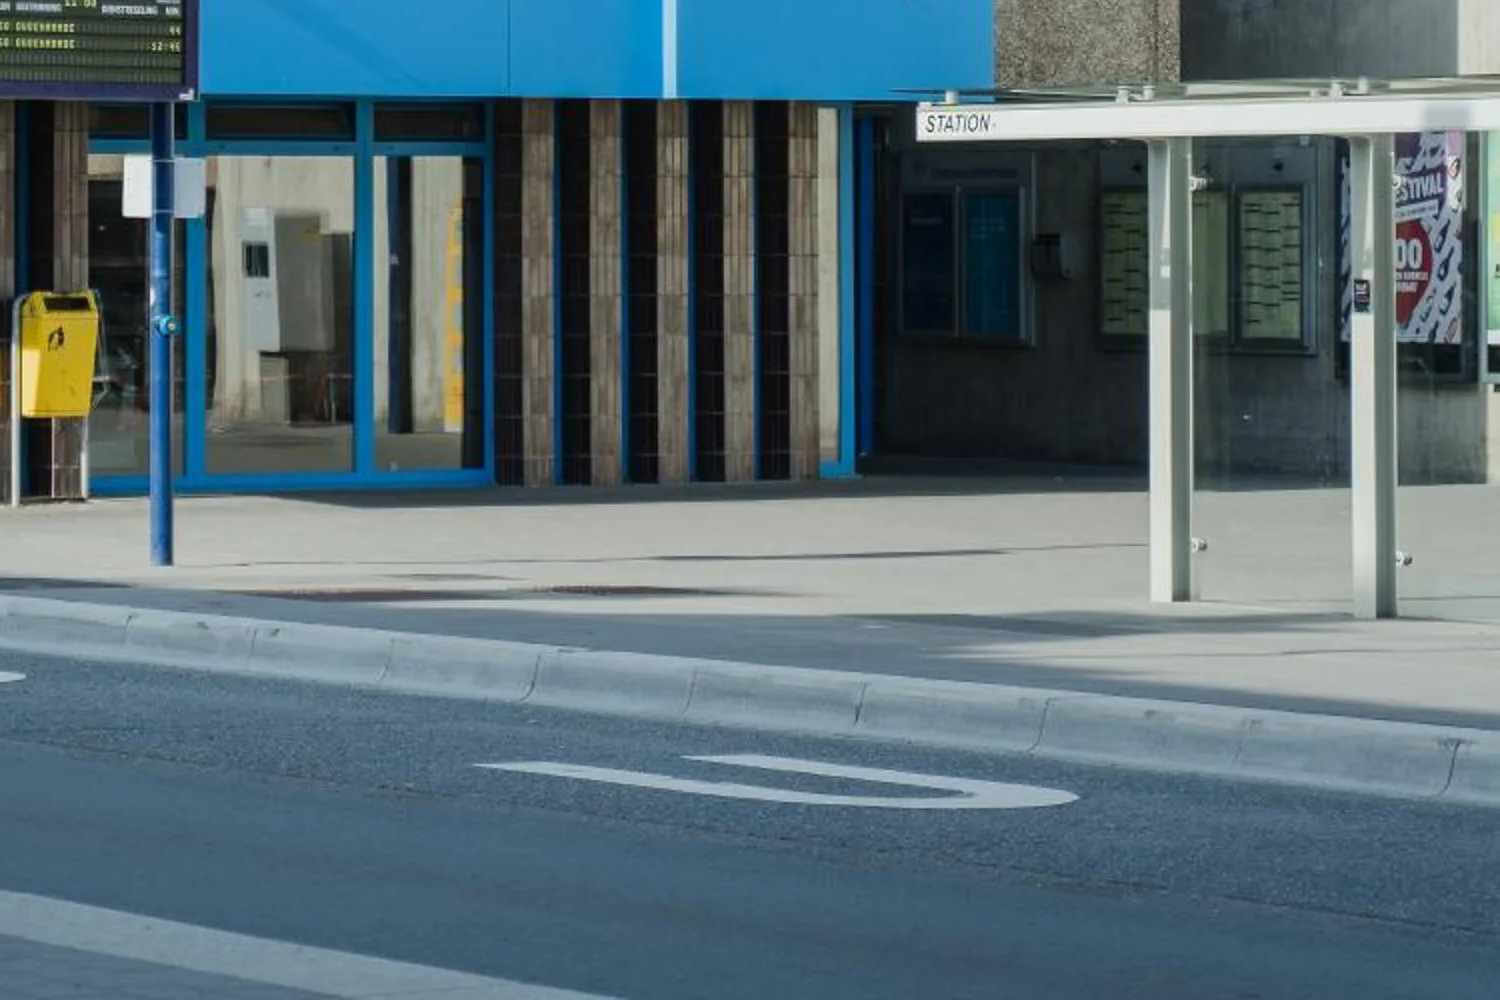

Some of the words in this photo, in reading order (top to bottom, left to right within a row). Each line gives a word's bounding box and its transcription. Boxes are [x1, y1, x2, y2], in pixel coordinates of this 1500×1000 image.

[926, 114, 991, 133] STATION
[1396, 172, 1445, 202] STIVAL
[1396, 238, 1423, 269] 00
